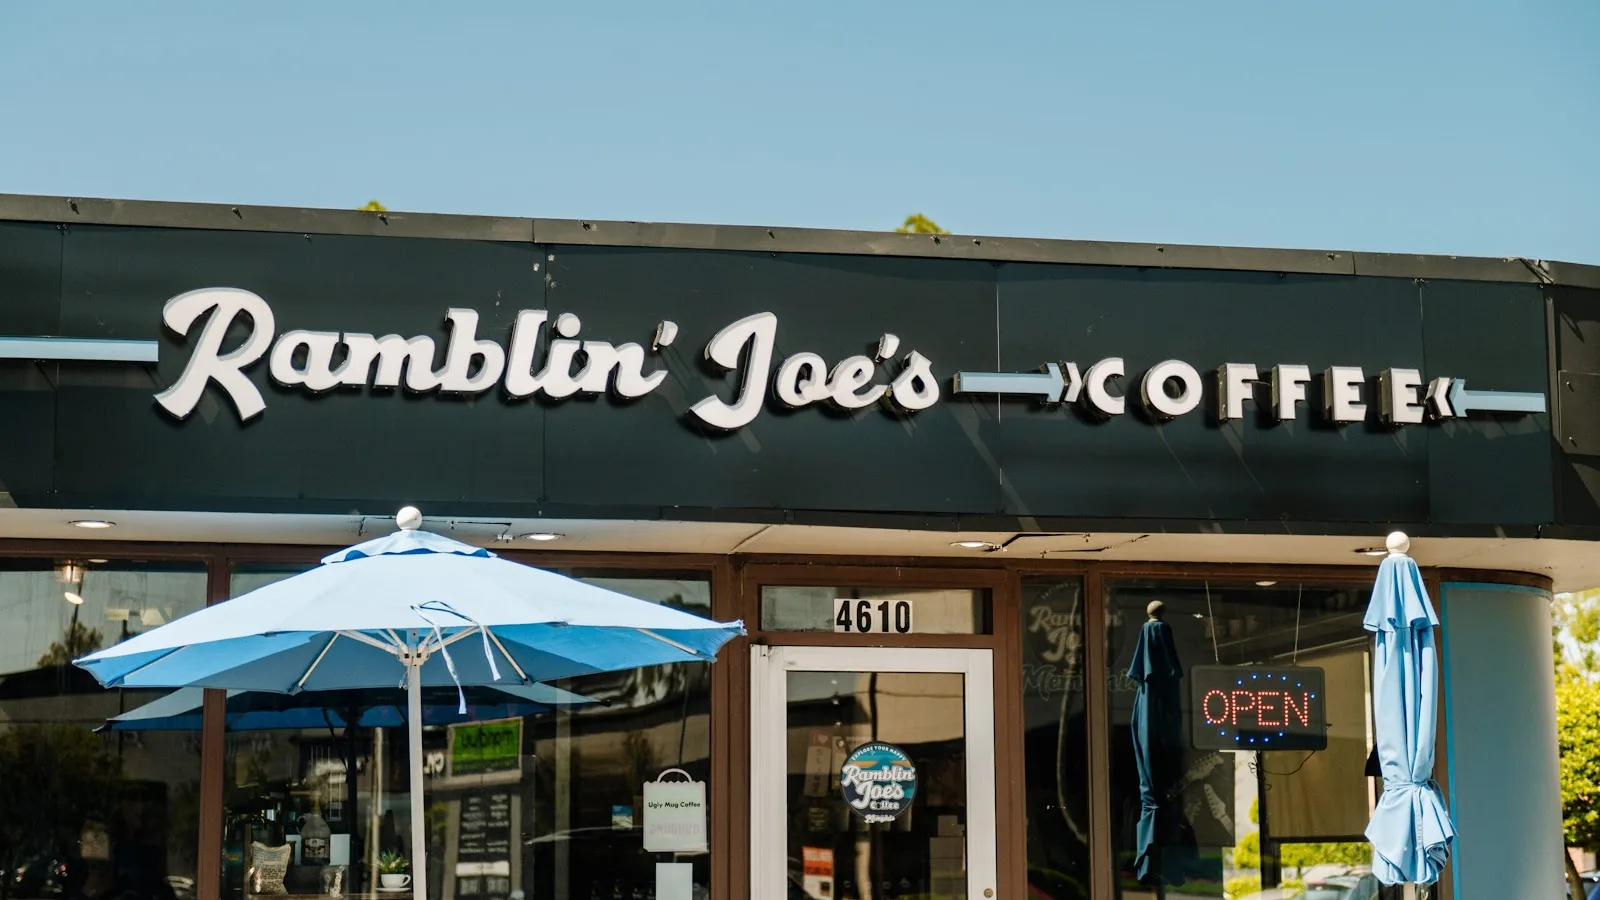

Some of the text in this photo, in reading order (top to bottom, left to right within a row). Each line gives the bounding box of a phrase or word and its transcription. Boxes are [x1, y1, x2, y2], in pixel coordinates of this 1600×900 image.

[153, 286, 1426, 430] Ramblin' Joe's COFFEE
[836, 600, 911, 633] 4610
[1203, 689, 1309, 727] OPEN
[851, 745, 874, 761] EXPLORE
[889, 748, 907, 761] HAPPY
[841, 764, 916, 787] Ramblin'
[850, 780, 905, 810] Joe's
